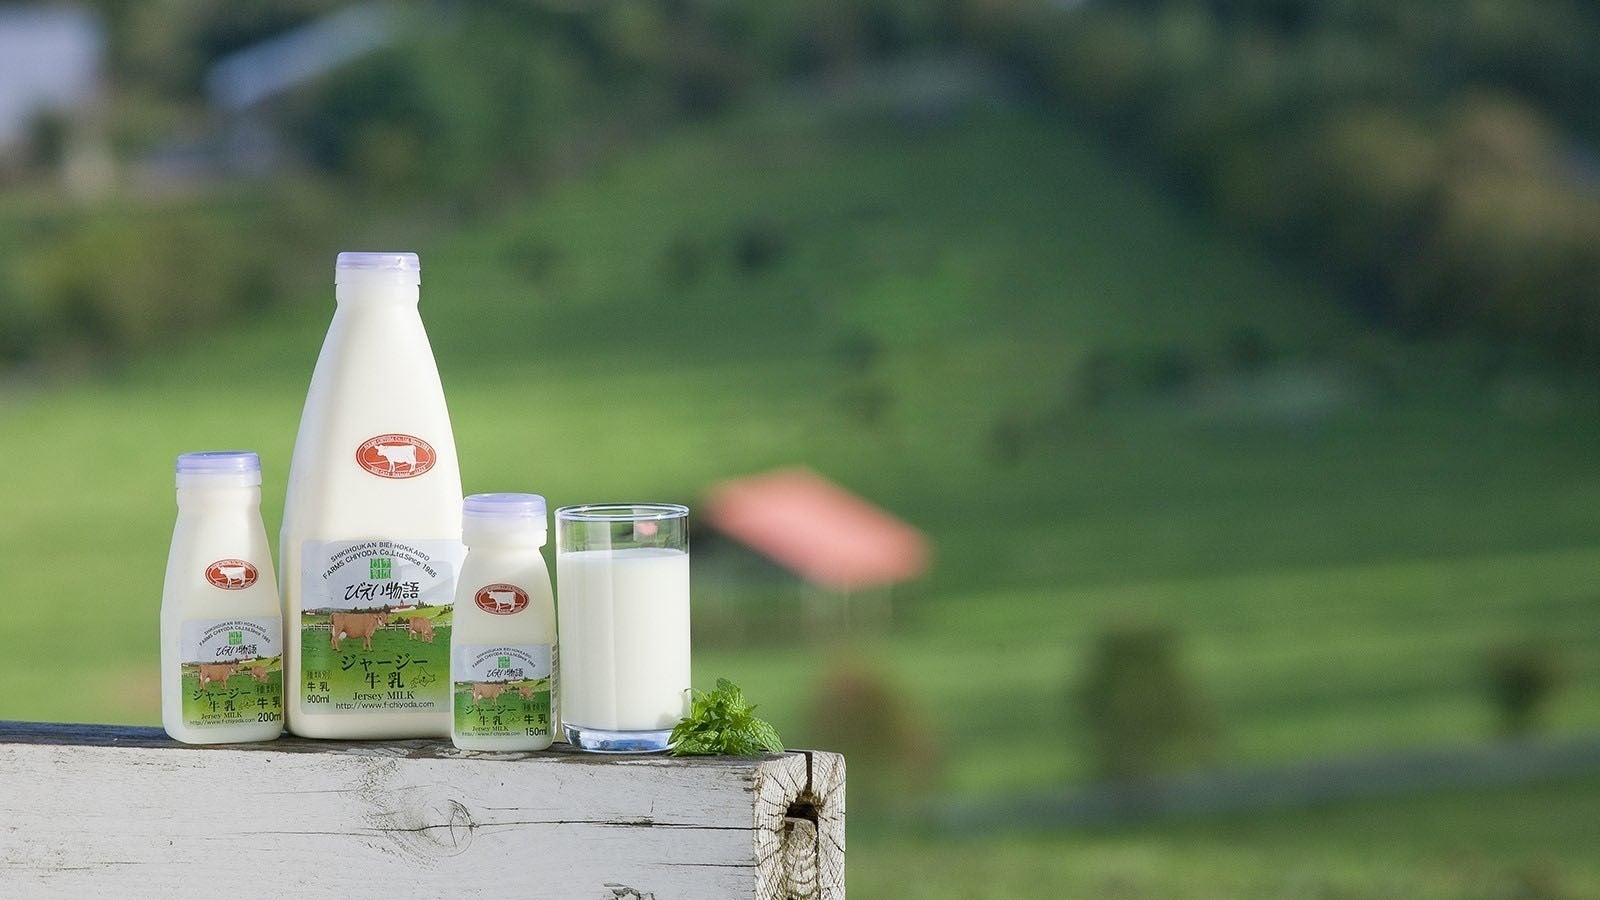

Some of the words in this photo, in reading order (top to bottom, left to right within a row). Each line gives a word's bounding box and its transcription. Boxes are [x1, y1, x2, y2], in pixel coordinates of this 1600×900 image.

[322, 560, 345, 580] FARMS
[345, 549, 378, 563] CHIYODA
[341, 653, 428, 671] ジャージー
[364, 672, 405, 689] 牛乳
[307, 681, 330, 692] 牛乳
[193, 687, 251, 701] ジャージー
[306, 694, 330, 704] 900ml
[353, 692, 384, 701] Jersey
[387, 691, 415, 700] MILK
[335, 701, 435, 710] http://www.f-chiyoda.com
[525, 726, 548, 737] 150ml
